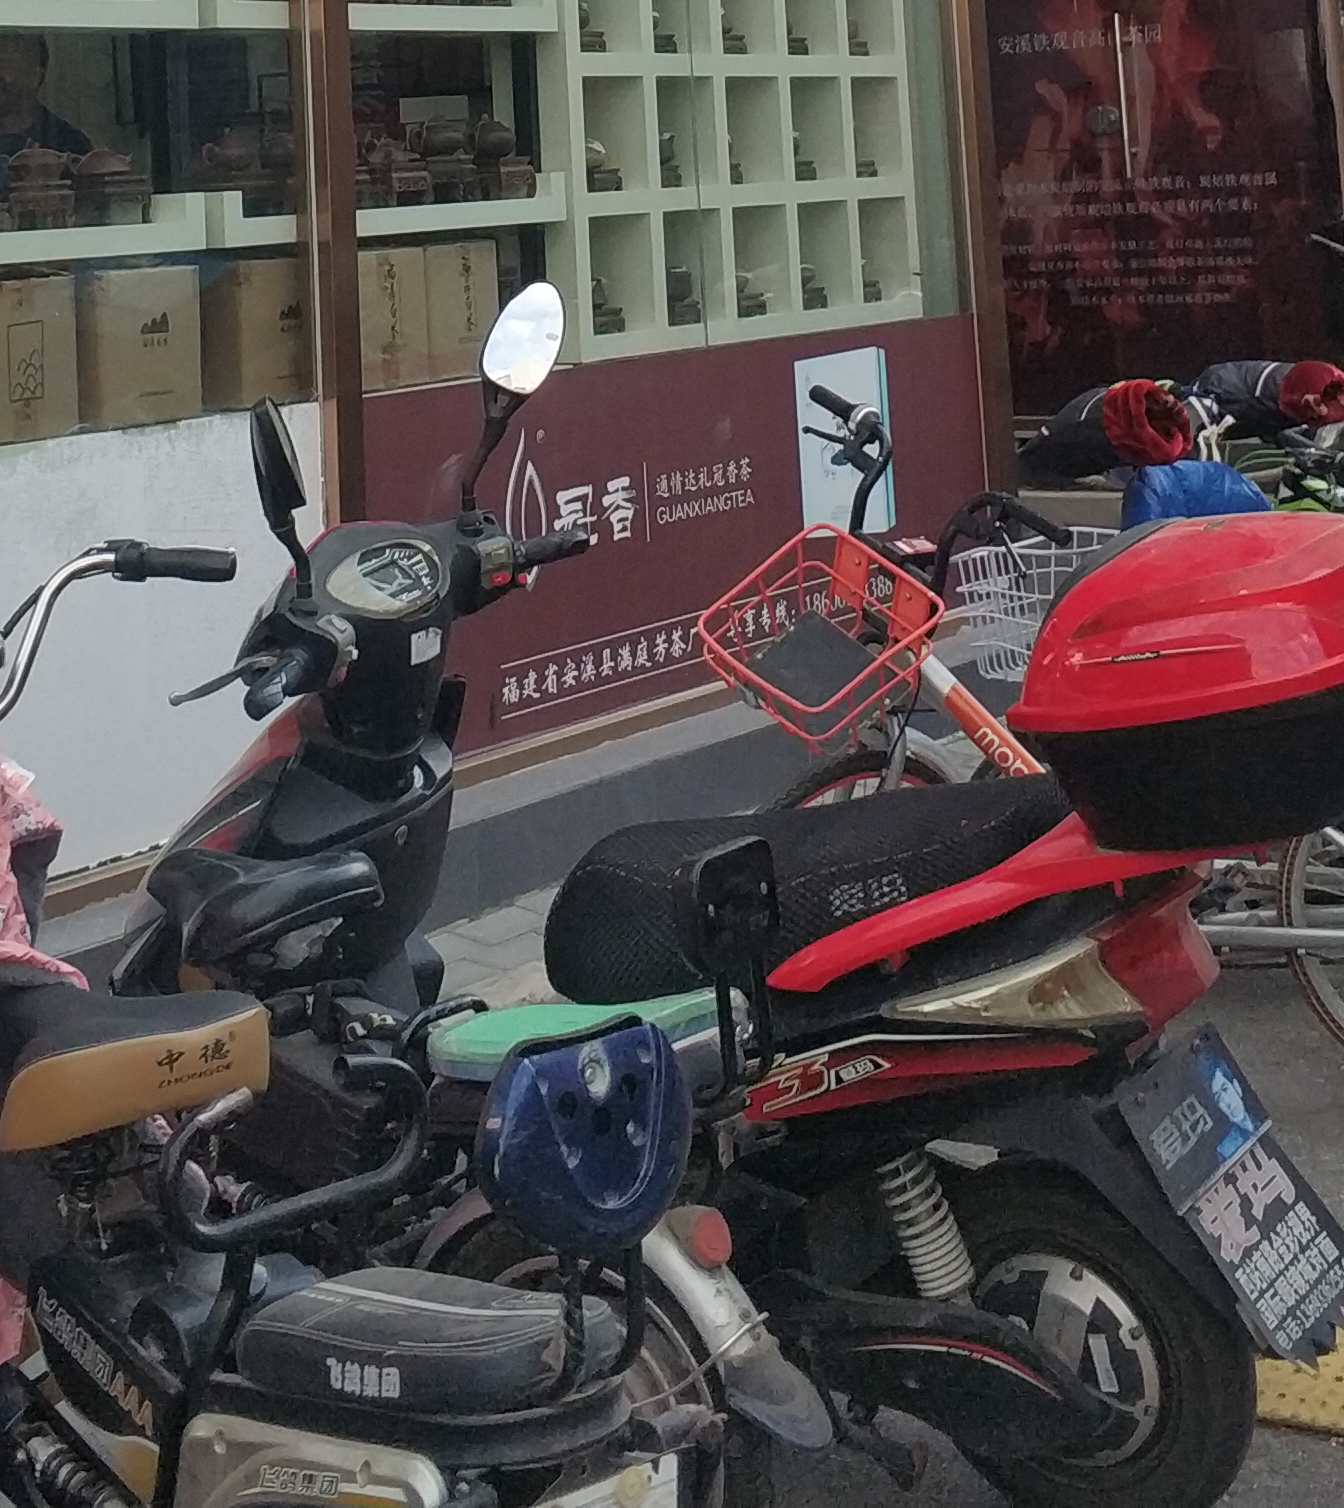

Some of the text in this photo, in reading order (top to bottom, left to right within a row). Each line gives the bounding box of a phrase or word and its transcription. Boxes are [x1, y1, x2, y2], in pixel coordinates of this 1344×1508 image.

[655, 455, 754, 499] 通情达礼冠香茶
[656, 488, 756, 526] GUANXIANGTEA
[502, 625, 703, 706] 福建省安溪县满庭芳茶厂
[1195, 1143, 1296, 1264] 爱玛
